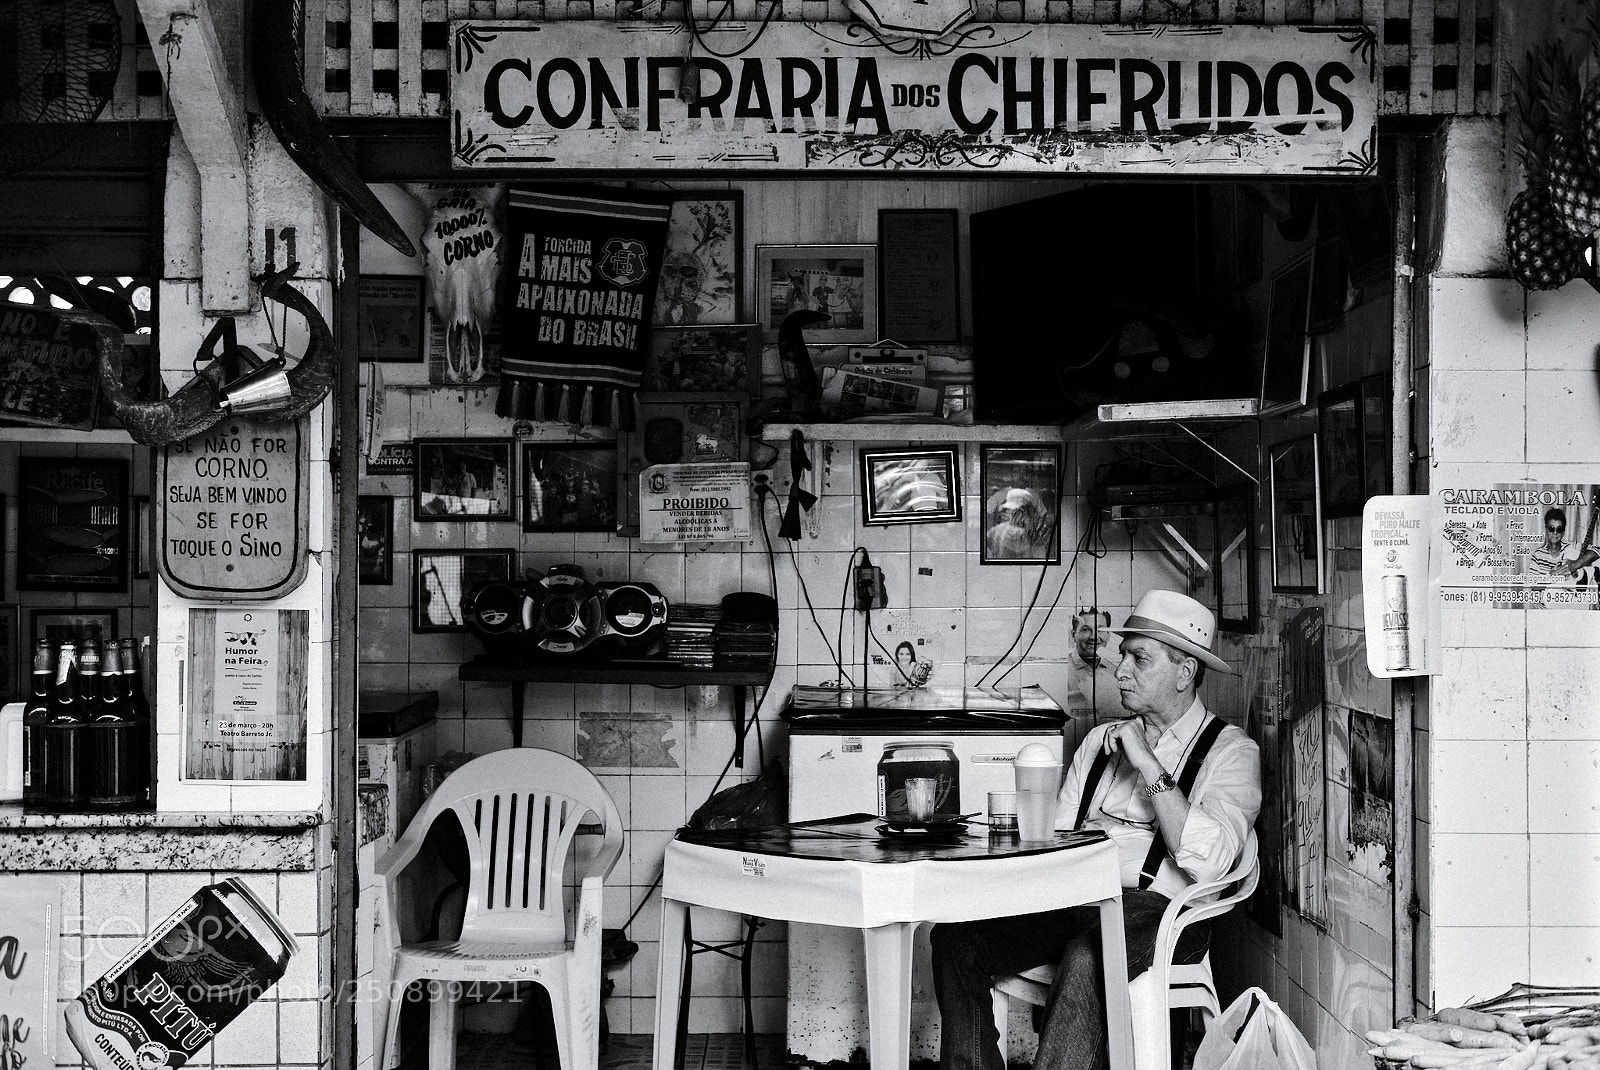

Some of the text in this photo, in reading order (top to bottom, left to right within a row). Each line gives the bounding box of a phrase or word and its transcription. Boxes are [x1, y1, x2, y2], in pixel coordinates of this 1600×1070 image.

[484, 53, 1354, 135] CONFRARIA DOS CHIFRUDOS
[444, 230, 493, 266] CORNO
[518, 232, 536, 278] A
[544, 236, 592, 255] TORCIDA
[541, 254, 592, 284] MAIS
[516, 283, 644, 320] APAIXONADA
[538, 316, 638, 351] DO BRASIL
[205, 434, 241, 454] NÃO
[253, 438, 287, 453] FOR
[170, 487, 287, 504] SEJA BEM VINDO
[663, 497, 729, 509] PROIBIDO
[1438, 488, 1588, 506] CARAMBOLA
[1375, 512, 1405, 520] DEVASSA
[1444, 506, 1540, 515] TECLADO E VIOLA
[197, 513, 268, 529] SE FOR
[1379, 520, 1421, 529] PURO MALTE
[170, 539, 216, 559] TOQUE
[222, 542, 232, 556] O
[1470, 591, 1487, 603] (81)
[225, 647, 258, 655] Humor
[134, 972, 217, 1050] PITÚ
[102, 1019, 116, 1027] PITÚ
[105, 1013, 136, 1030] ENVASADA
[135, 1029, 145, 1043] POR
